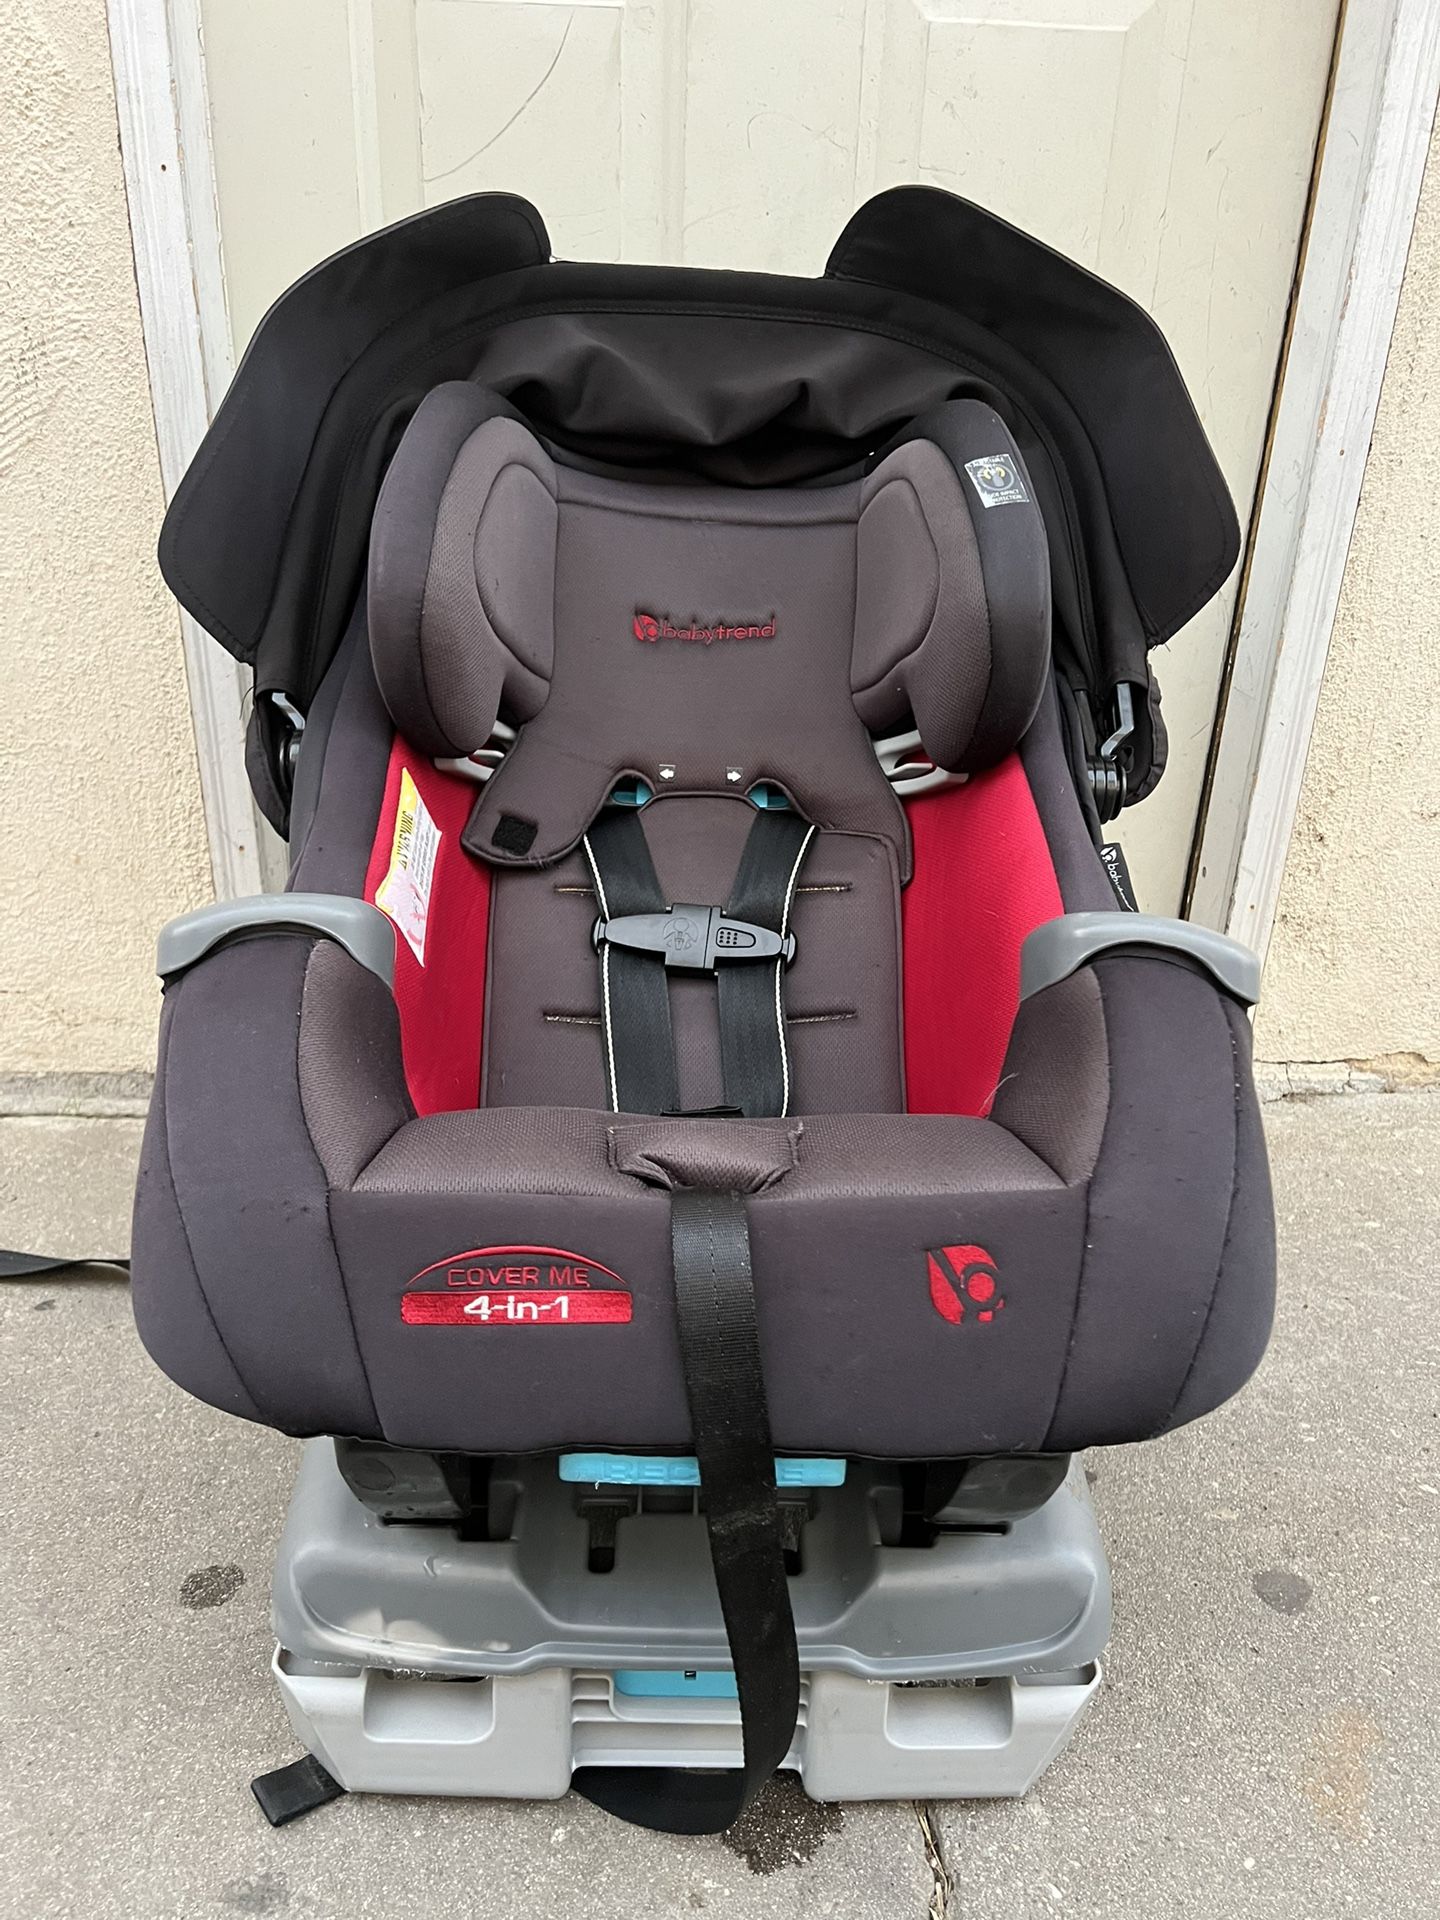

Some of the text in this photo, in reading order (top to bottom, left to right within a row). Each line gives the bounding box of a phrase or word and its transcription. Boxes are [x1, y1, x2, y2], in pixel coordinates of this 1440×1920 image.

[662, 617, 776, 646] babytrend
[447, 1266, 591, 1288] COVER ME
[463, 1295, 569, 1321] 4-in-1
